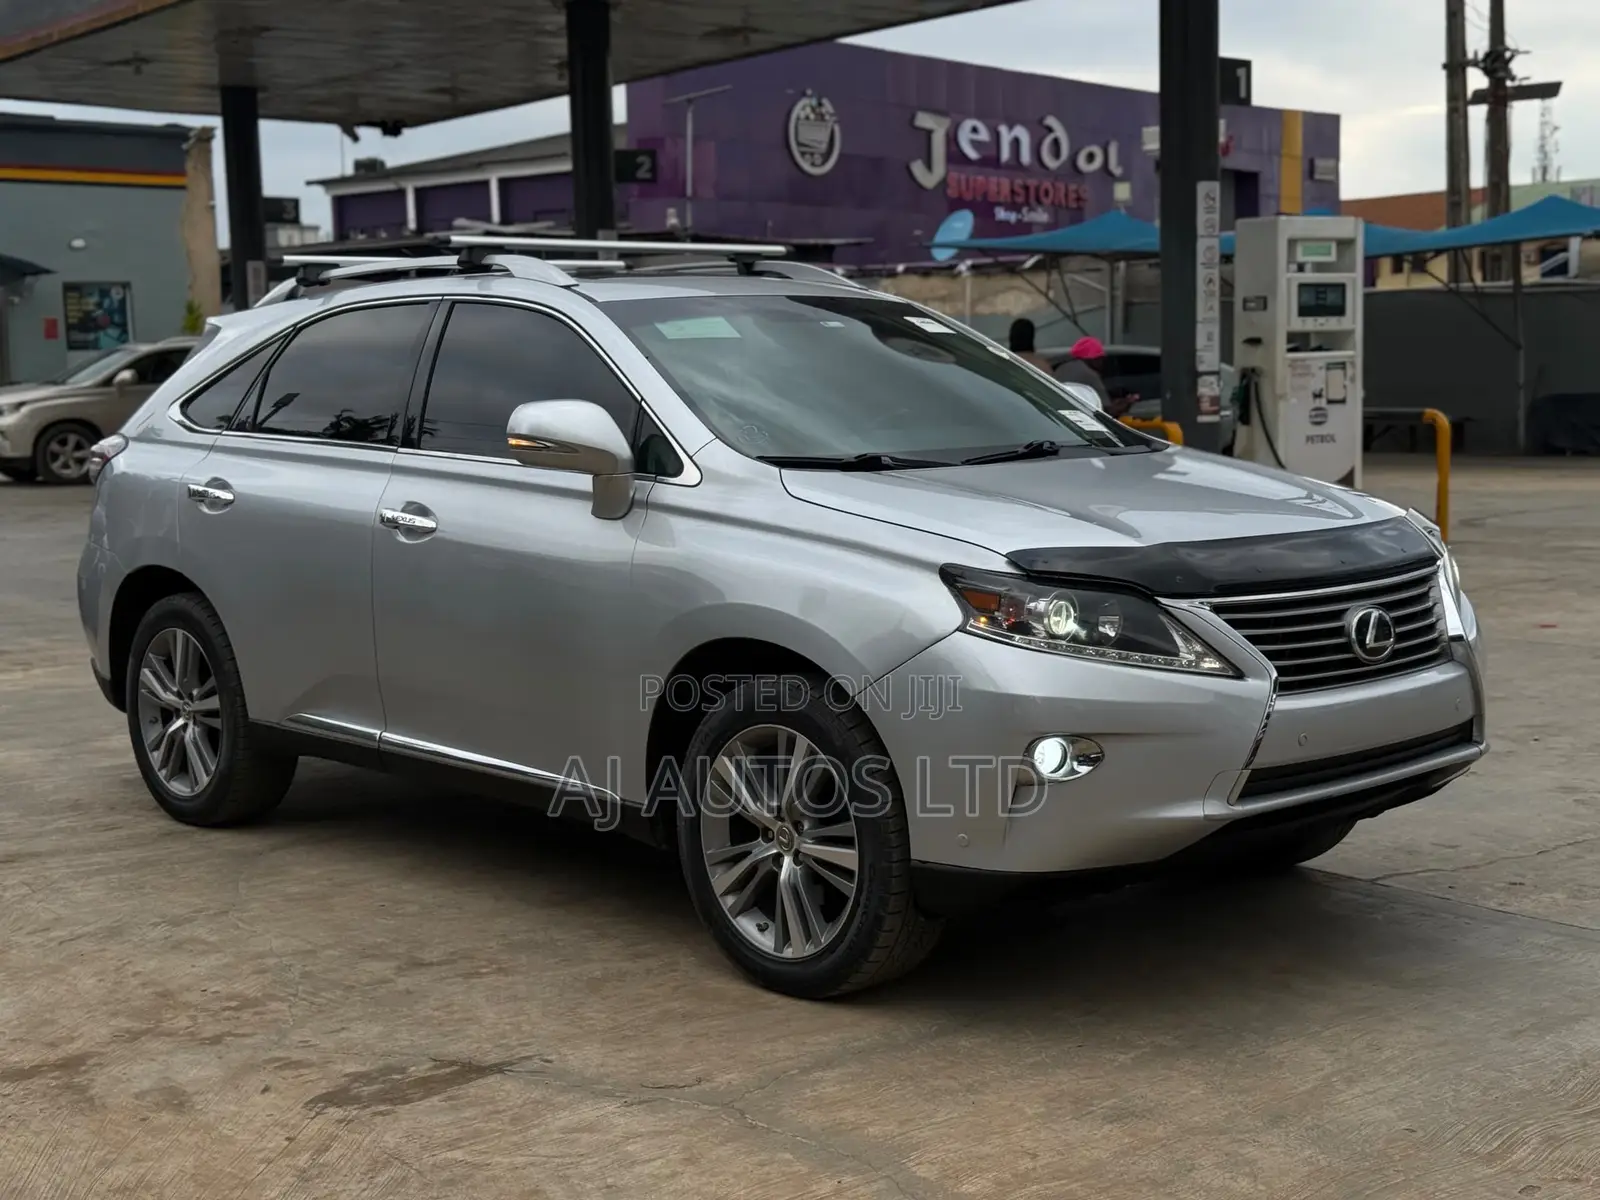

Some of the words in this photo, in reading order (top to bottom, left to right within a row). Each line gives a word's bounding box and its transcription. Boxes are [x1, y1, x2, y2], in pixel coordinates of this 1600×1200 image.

[1236, 66, 1247, 99] 1
[635, 155, 653, 179] 2
[908, 110, 1124, 190] Jendol
[946, 171, 1090, 209] SUPERSTORES
